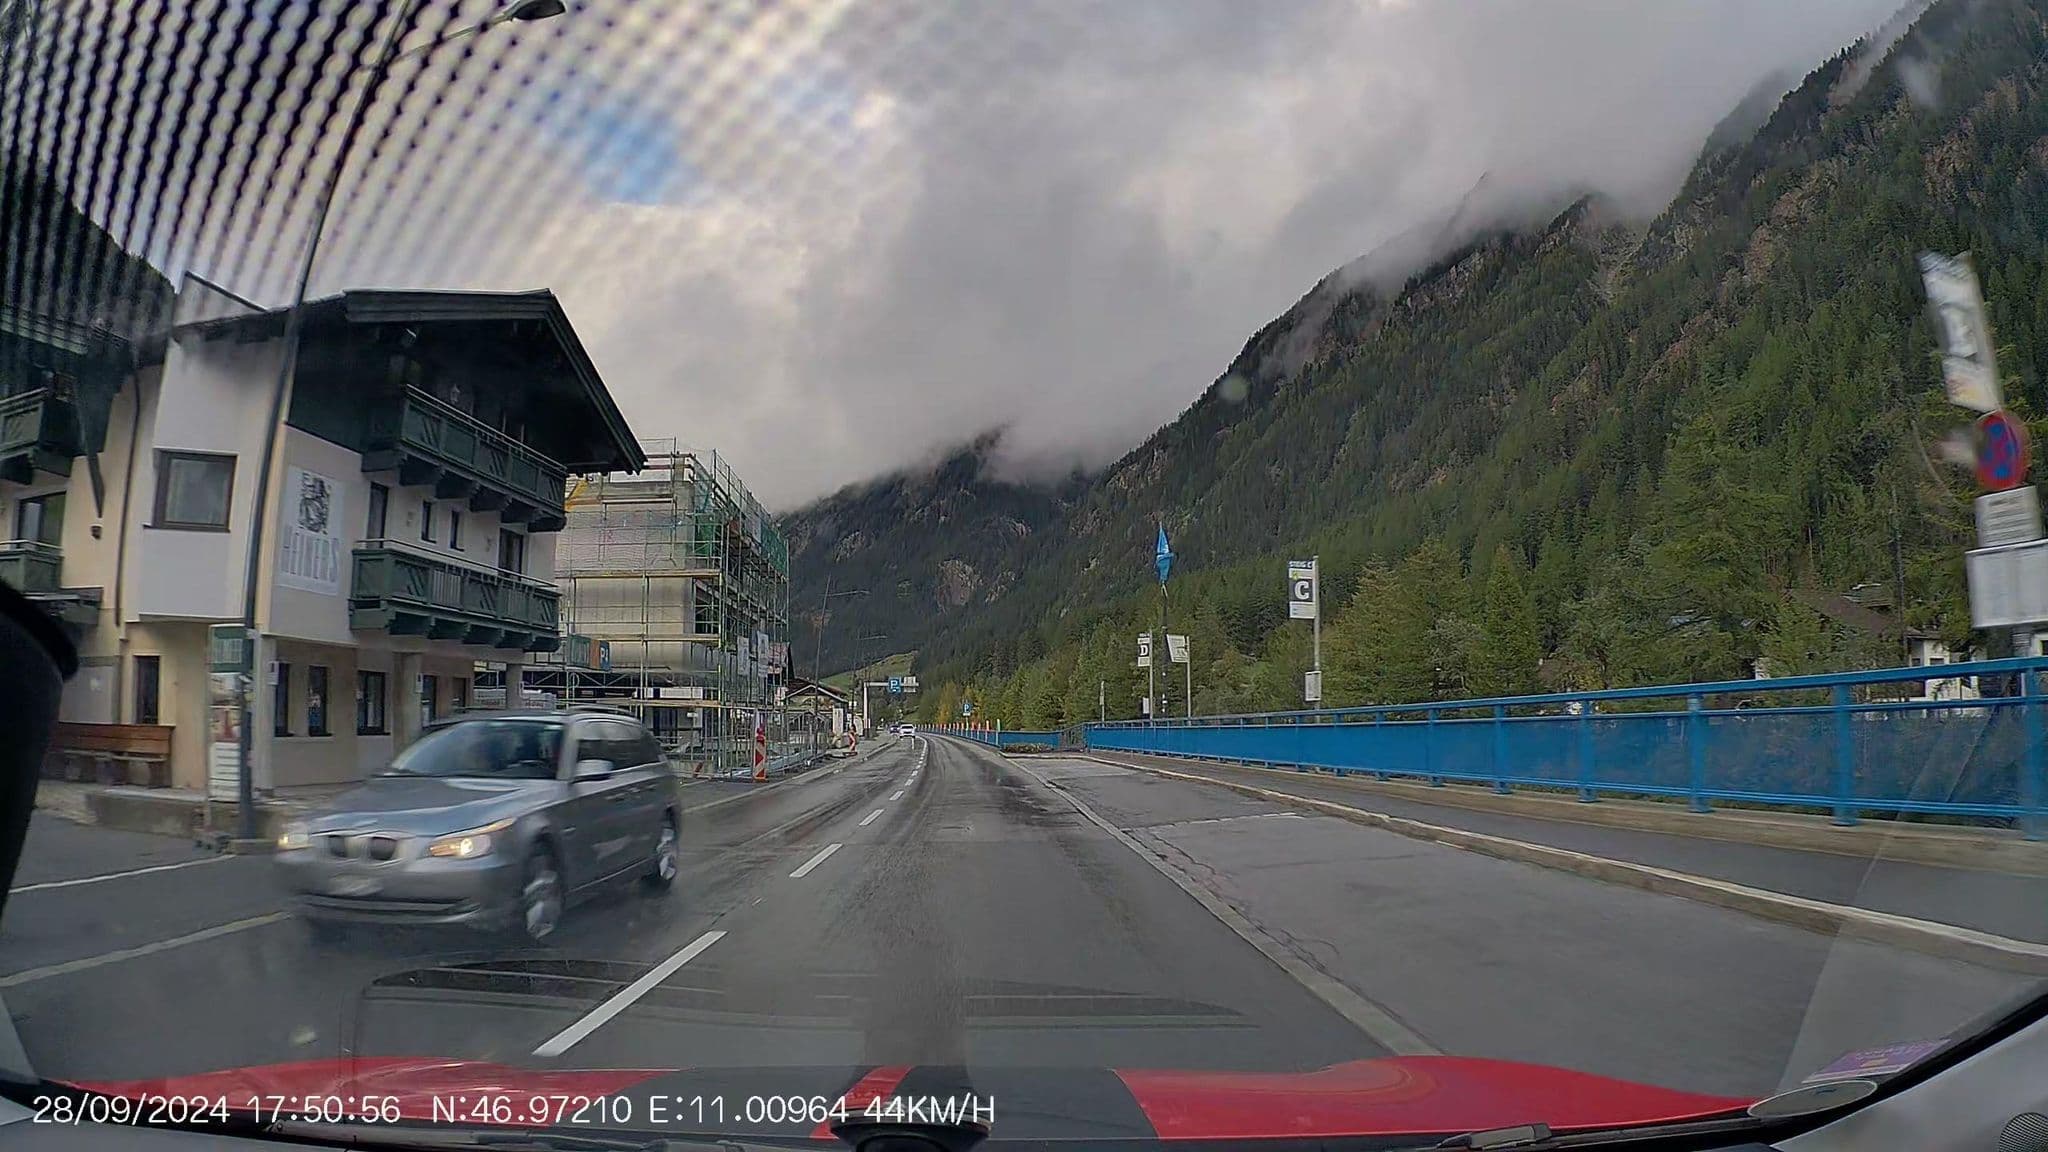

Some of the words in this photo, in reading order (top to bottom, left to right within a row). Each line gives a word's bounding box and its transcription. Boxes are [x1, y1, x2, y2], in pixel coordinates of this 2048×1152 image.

[1294, 580, 1309, 600] C
[1140, 645, 1149, 656] D
[890, 680, 898, 690] P
